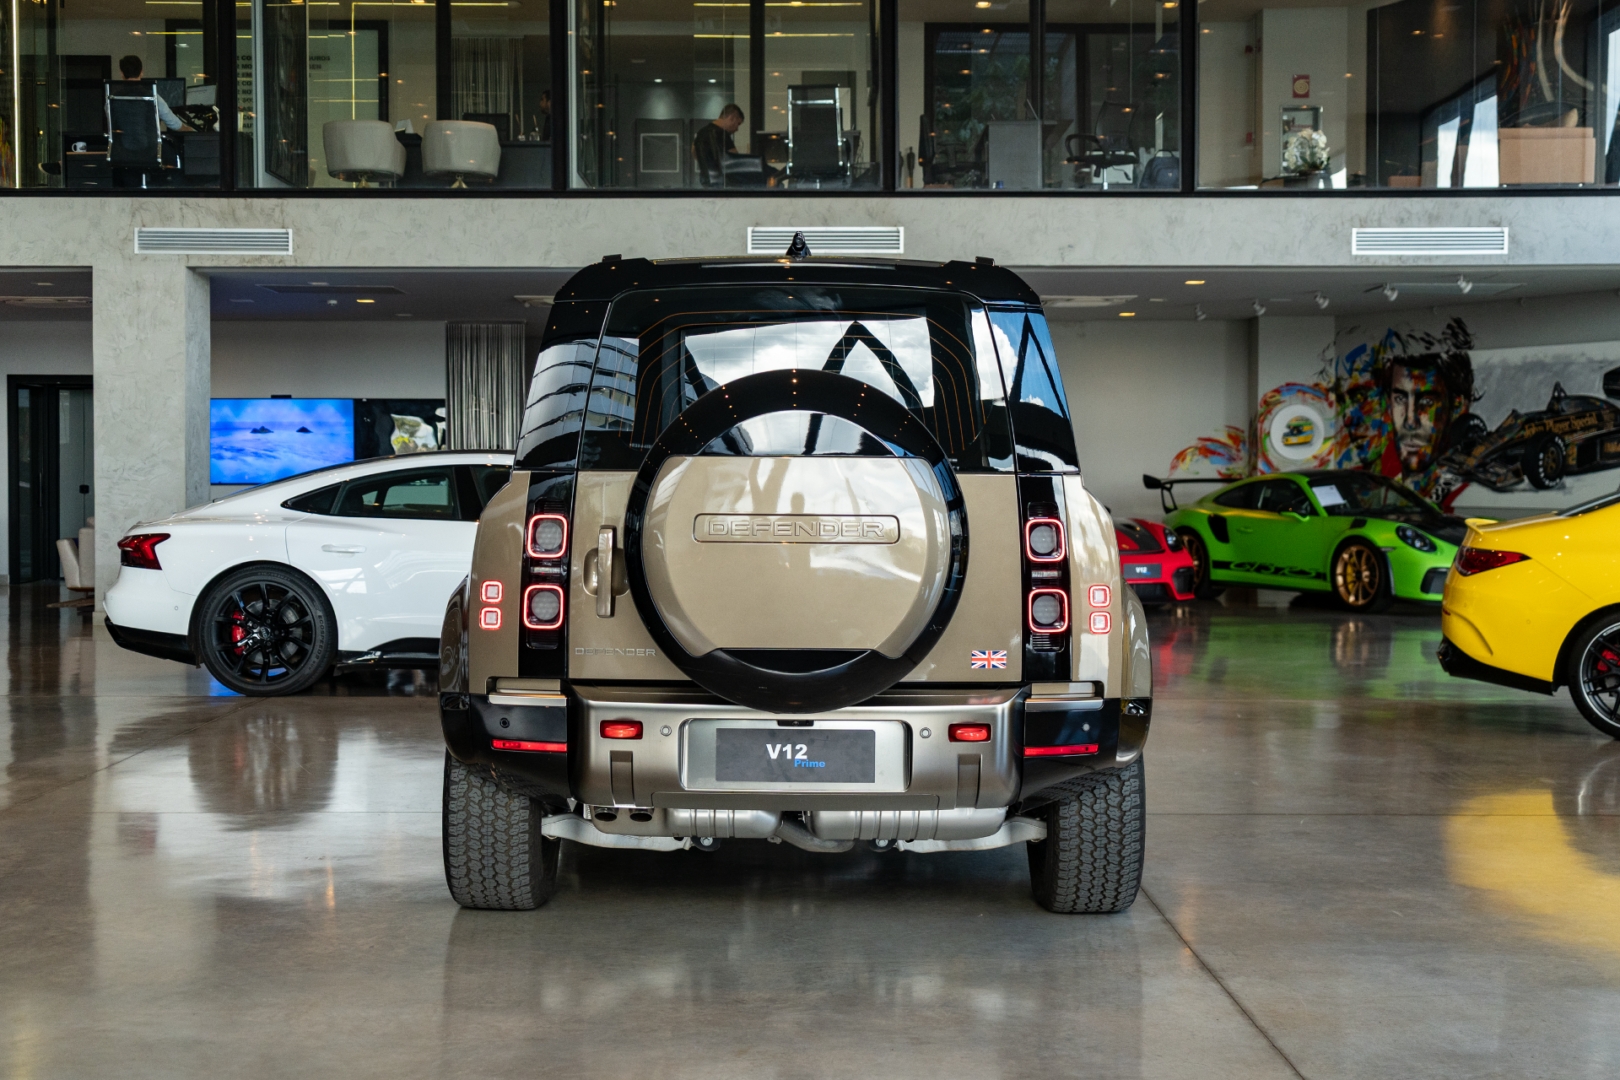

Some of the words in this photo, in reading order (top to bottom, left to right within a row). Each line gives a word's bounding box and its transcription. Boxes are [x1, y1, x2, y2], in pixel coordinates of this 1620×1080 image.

[708, 520, 885, 537] DEFENDER
[574, 647, 656, 656] DEFENDER
[766, 743, 808, 759] V12
[794, 759, 826, 768] Prime
